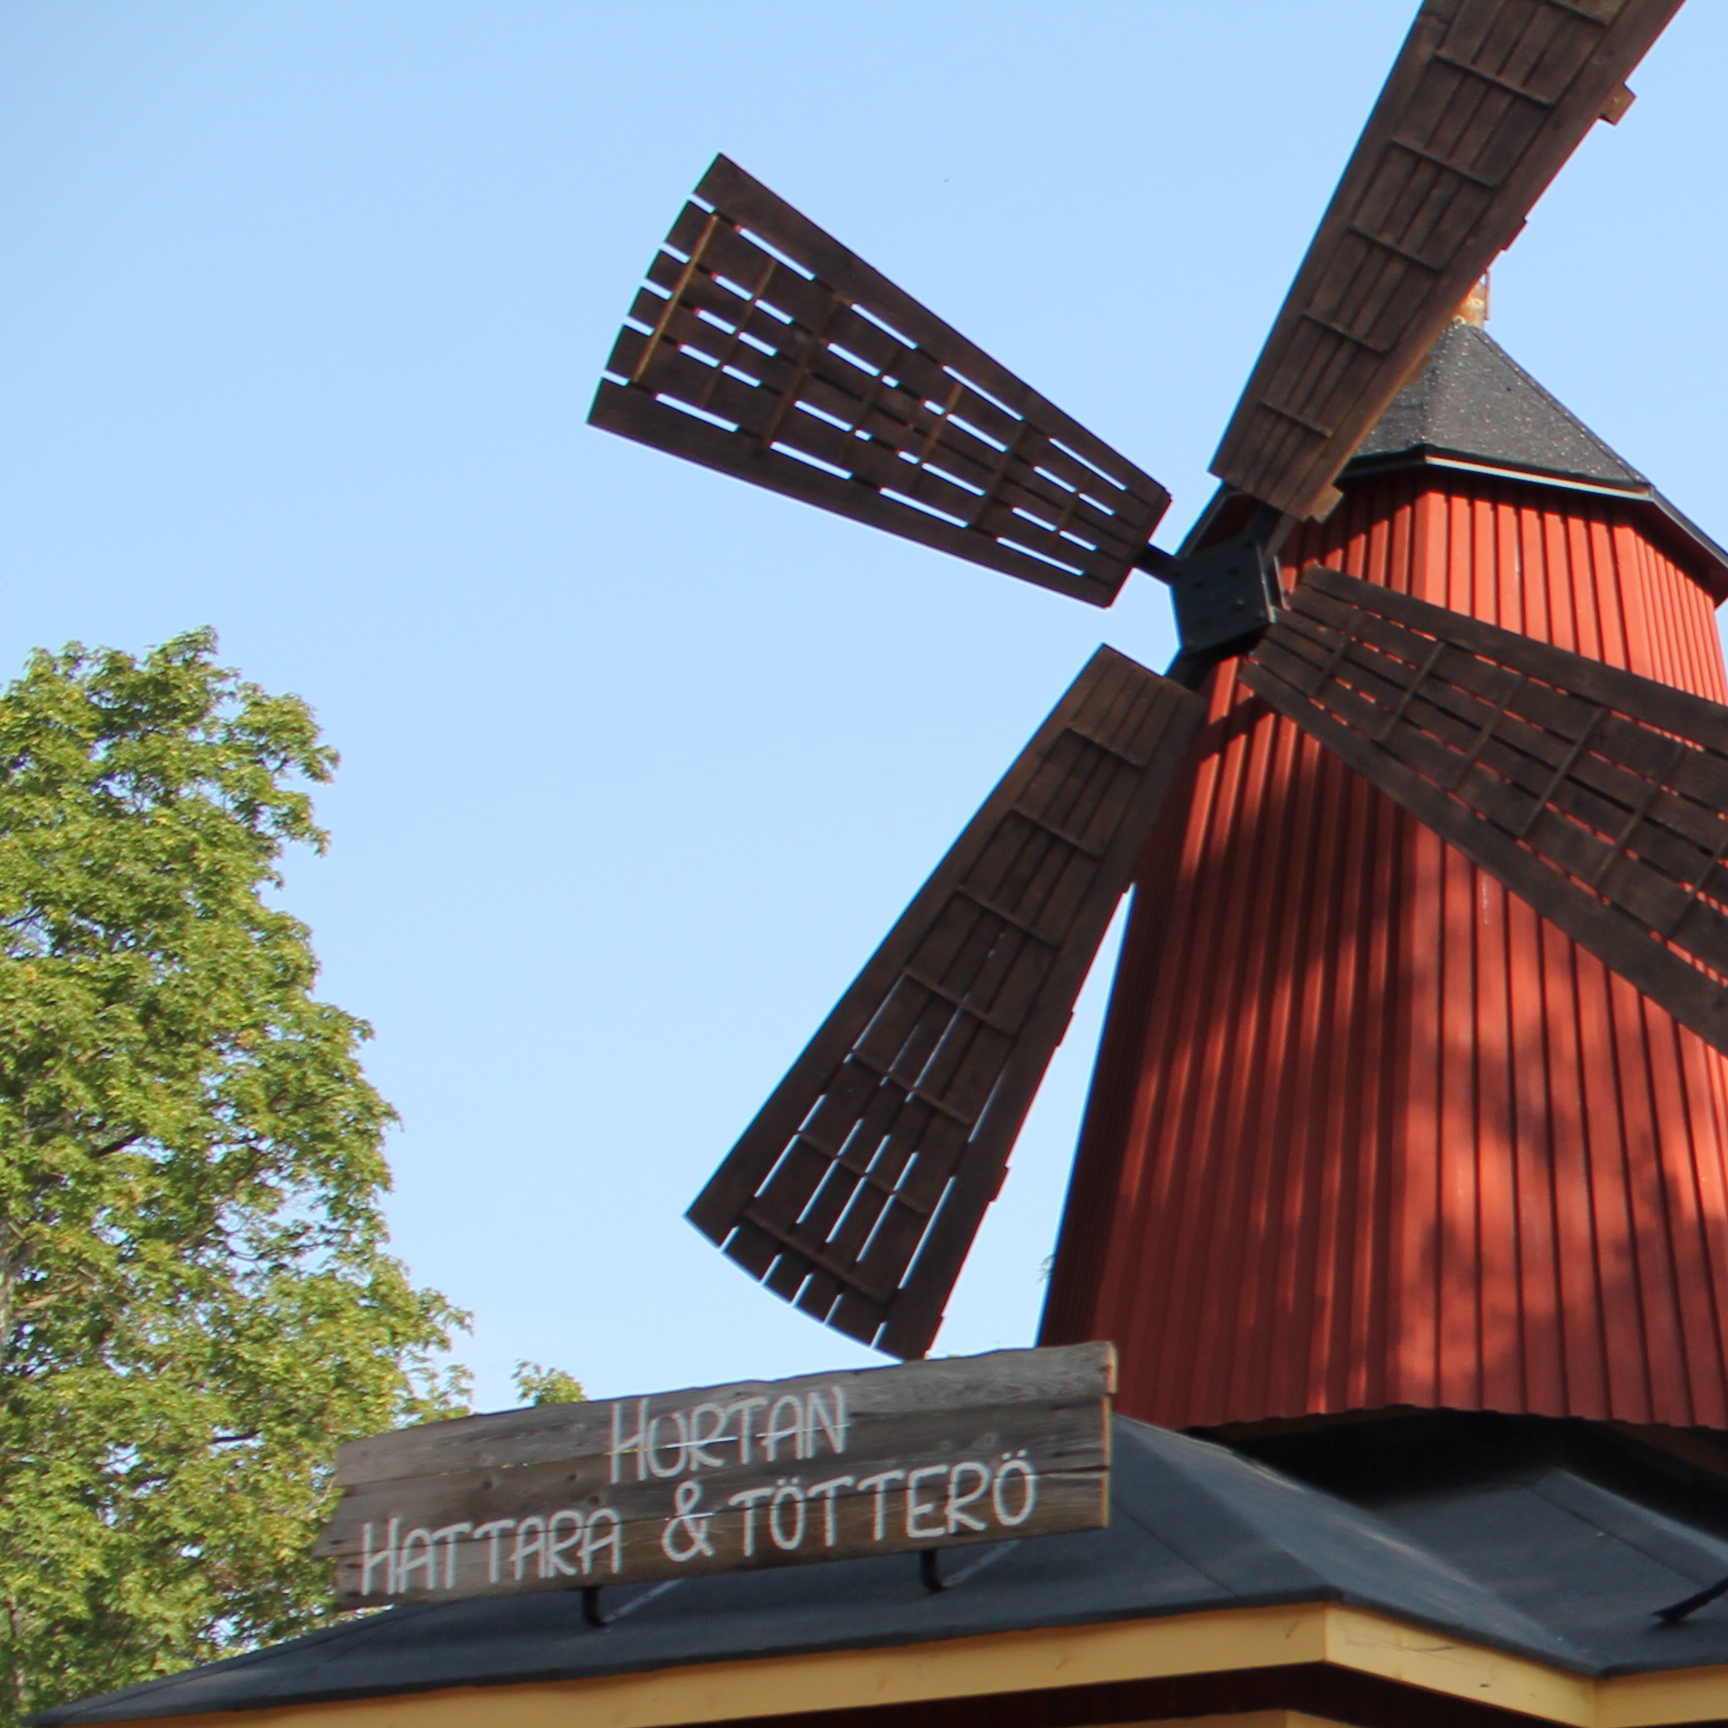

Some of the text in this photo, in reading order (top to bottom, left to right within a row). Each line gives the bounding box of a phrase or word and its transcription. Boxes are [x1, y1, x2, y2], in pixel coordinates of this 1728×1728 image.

[609, 1385, 848, 1485] HURTAN
[361, 1450, 1039, 1596] HATTARA & TÖTTERÖ
